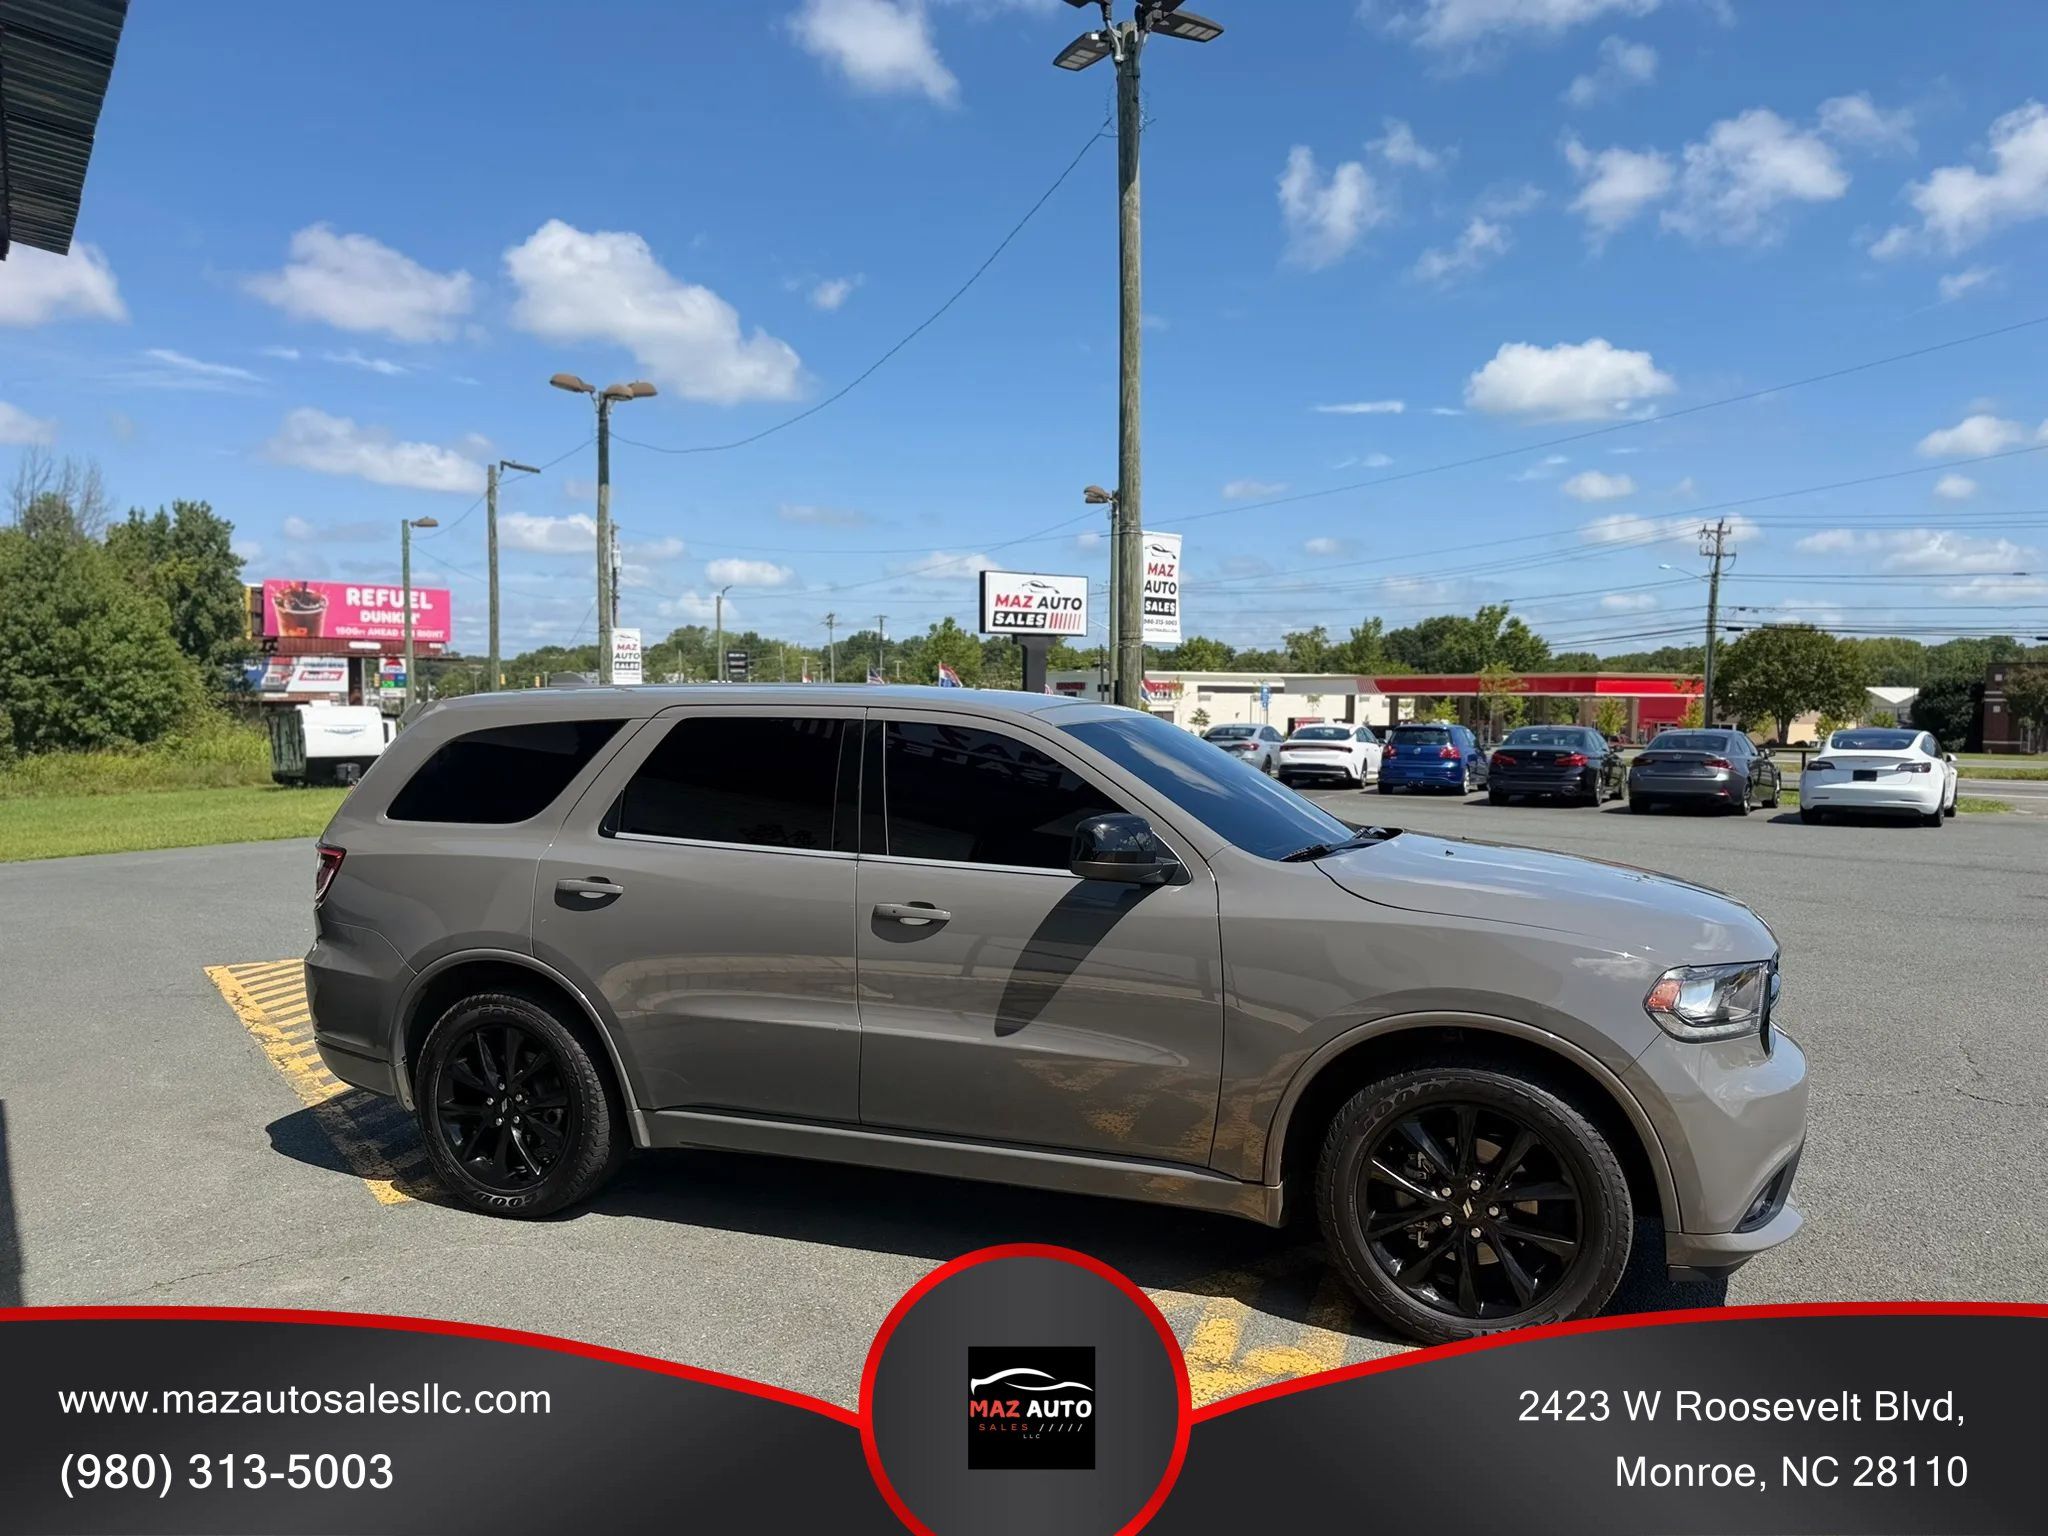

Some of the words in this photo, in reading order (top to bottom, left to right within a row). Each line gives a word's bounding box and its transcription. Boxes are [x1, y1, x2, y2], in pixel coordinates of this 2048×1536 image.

[1147, 562, 1175, 577] MAZ
[1144, 580, 1177, 595] AUTO
[346, 587, 434, 609] REFUEL
[995, 594, 1033, 609] MAZ
[1037, 596, 1083, 611] AUTO
[1145, 600, 1176, 613] SALES
[994, 612, 1045, 626] SALES
[615, 652, 640, 660] AUTO
